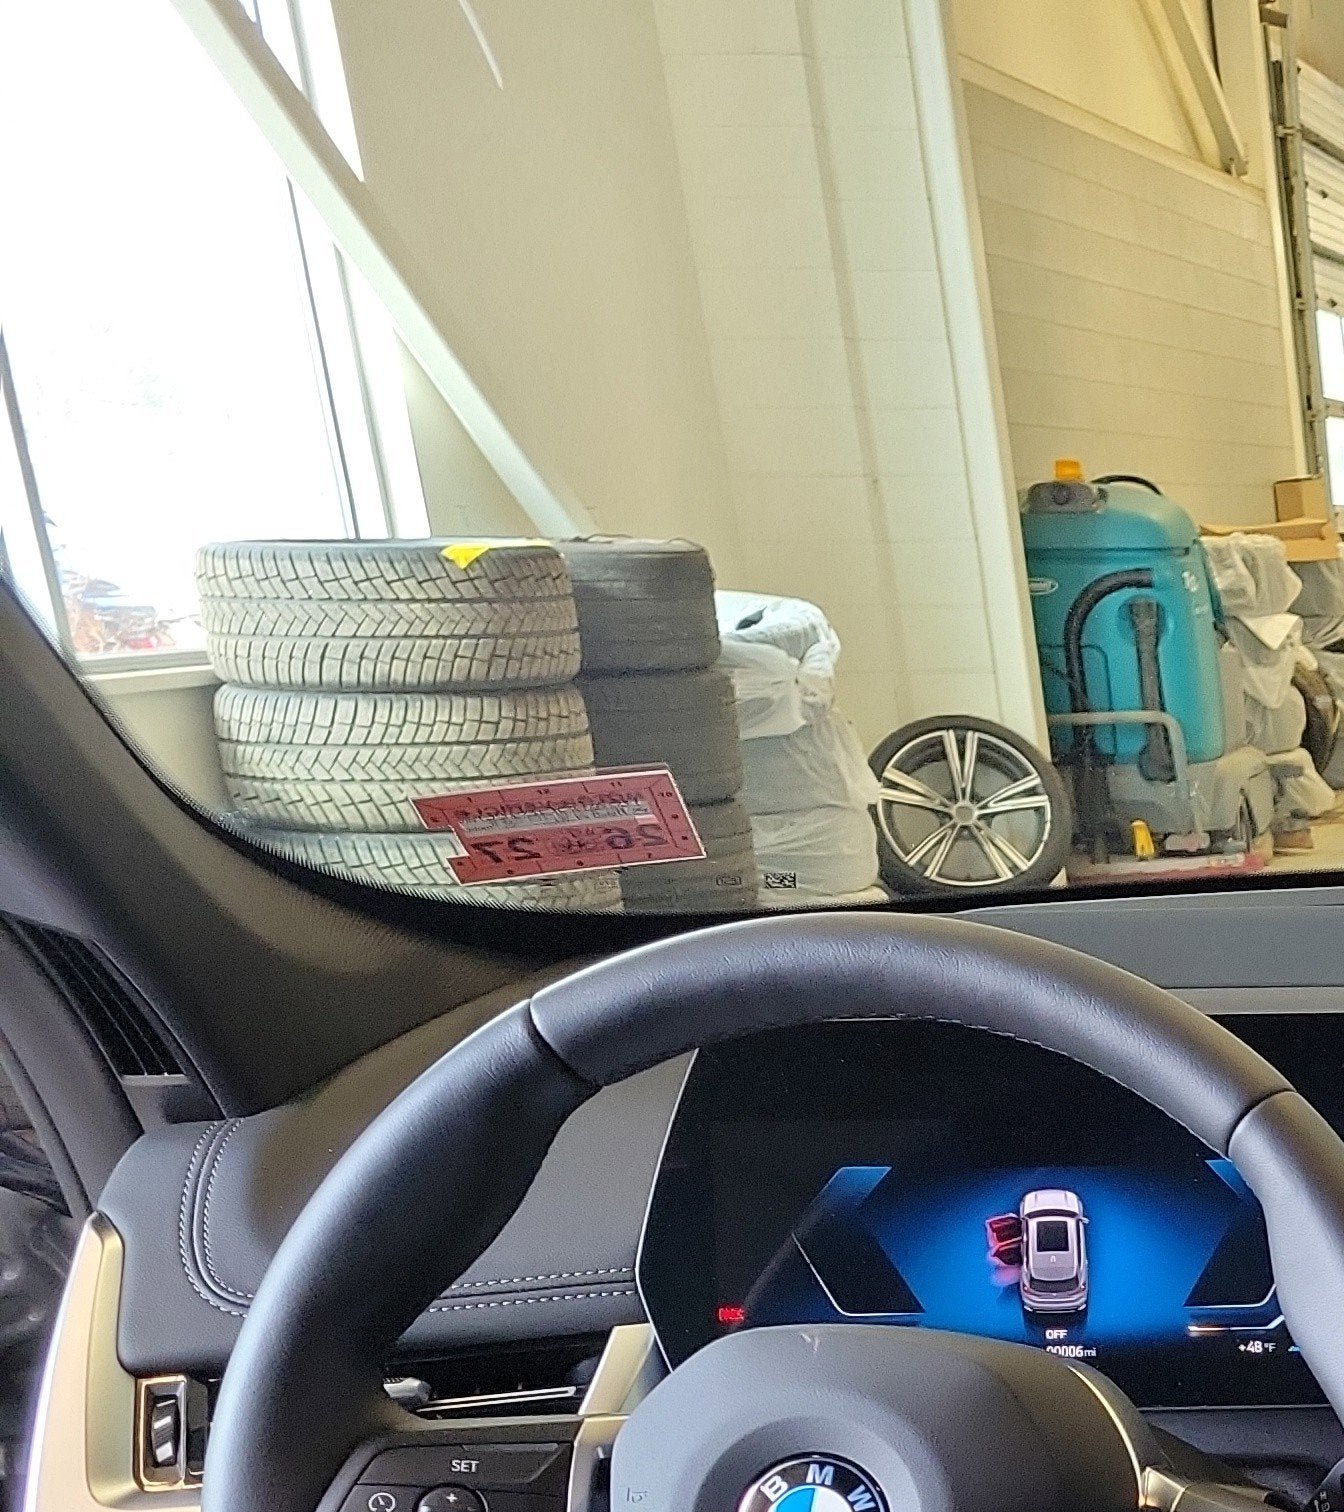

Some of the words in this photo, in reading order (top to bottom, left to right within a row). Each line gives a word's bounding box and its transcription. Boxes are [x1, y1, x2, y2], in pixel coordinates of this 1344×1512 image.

[1045, 1329, 1068, 1339] OFF
[1084, 1347, 1096, 1357] mi
[1238, 1341, 1262, 1353] +48
[451, 1459, 479, 1473] SET
[760, 1463, 876, 1512] BMW
